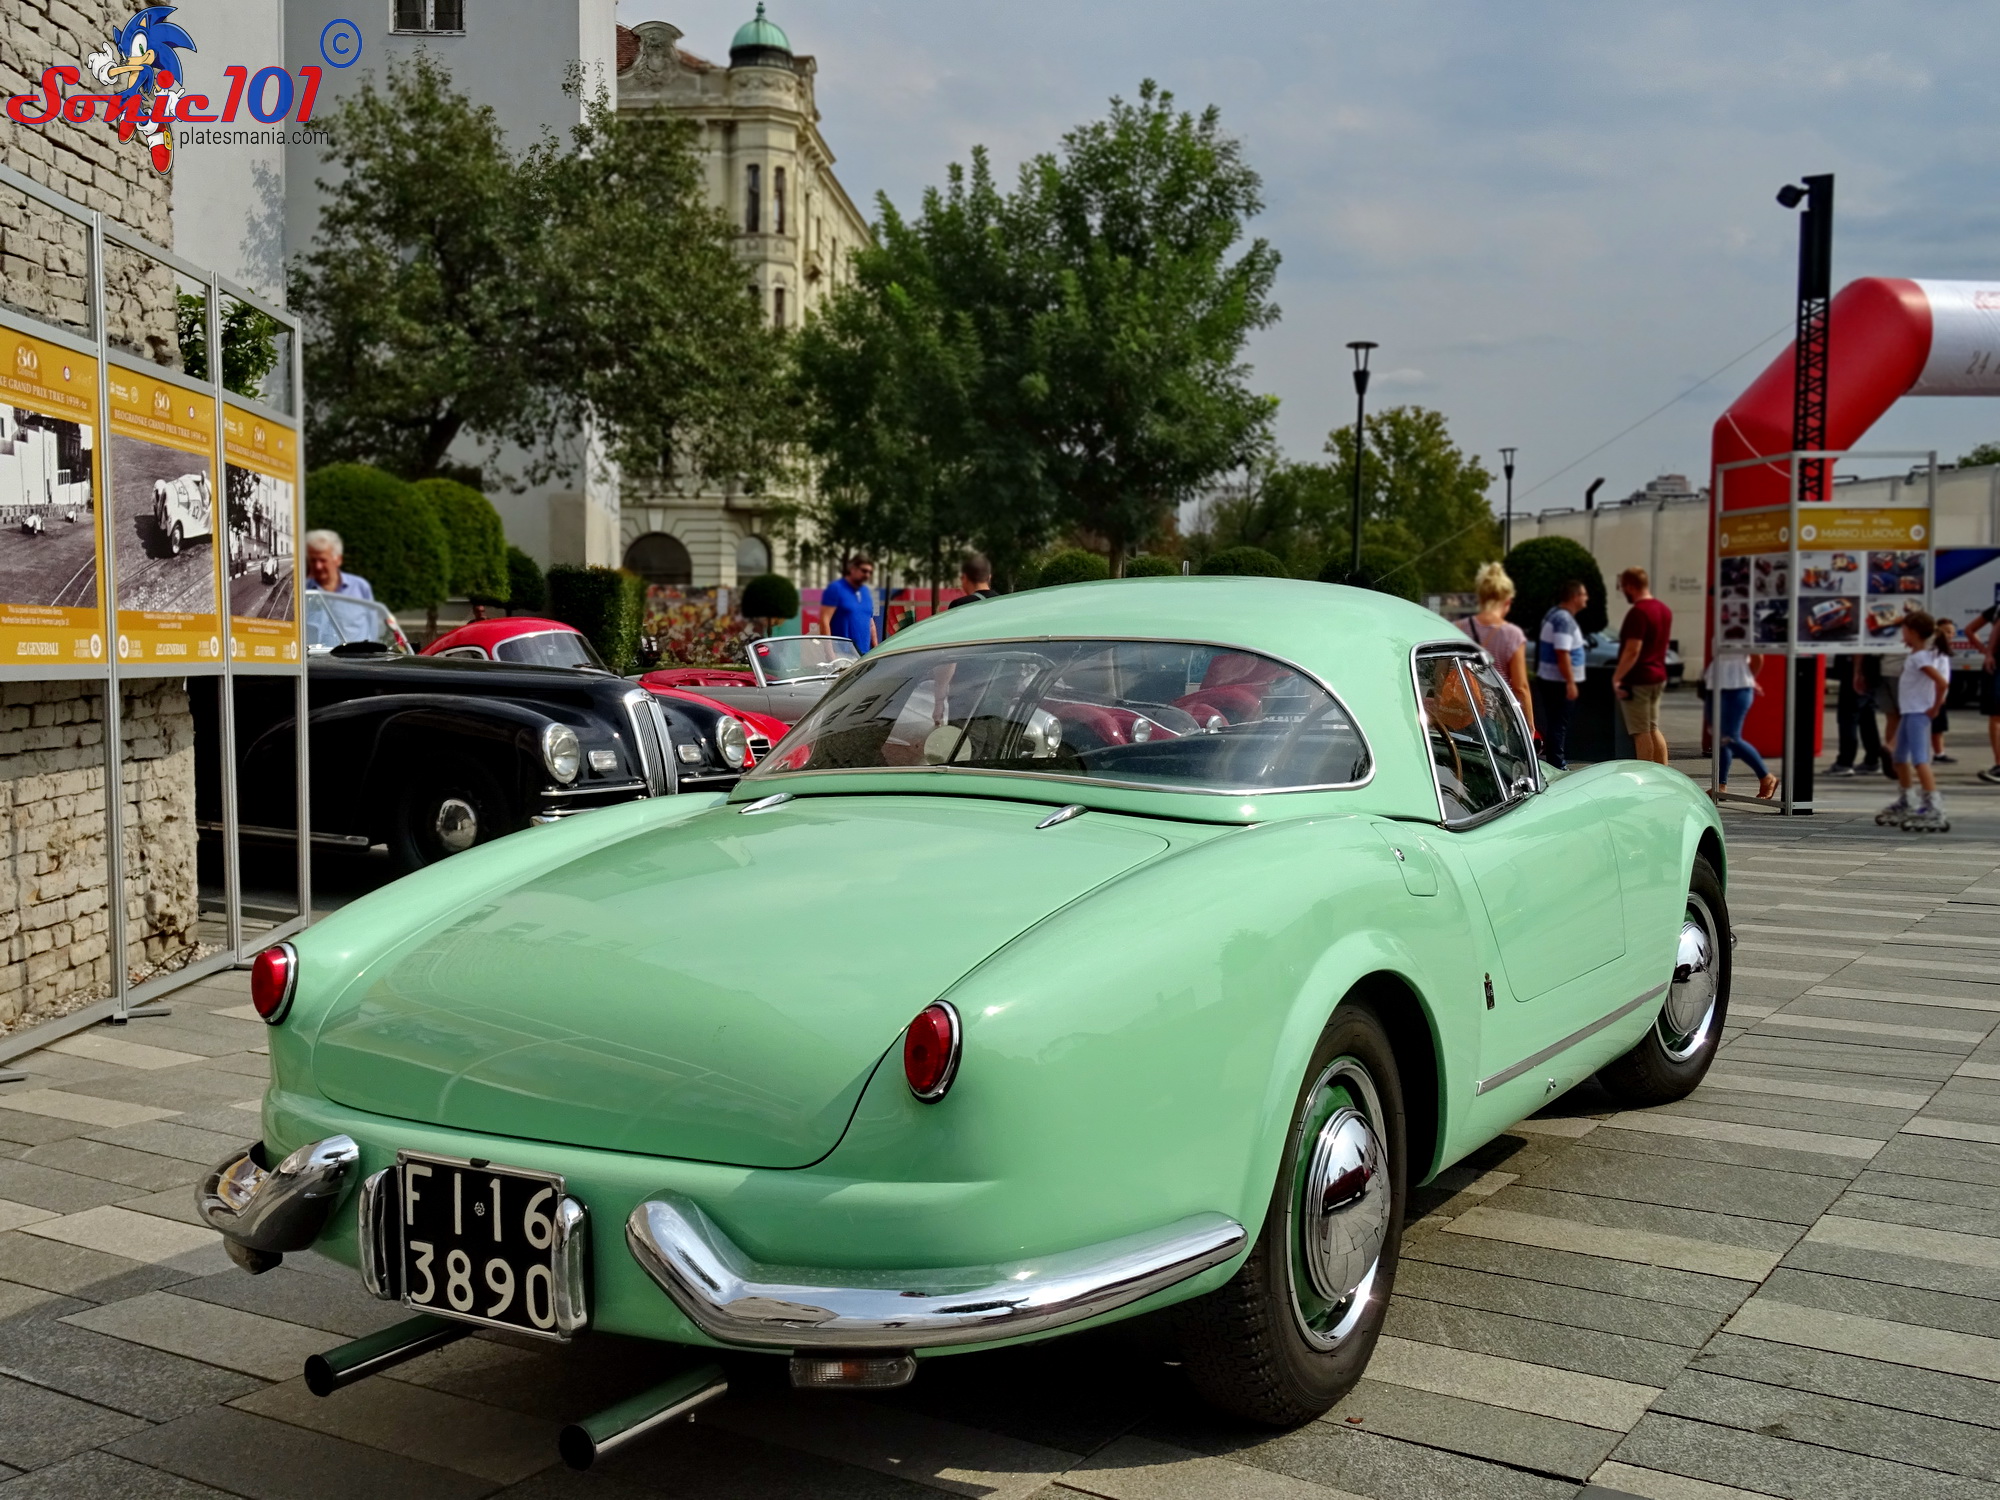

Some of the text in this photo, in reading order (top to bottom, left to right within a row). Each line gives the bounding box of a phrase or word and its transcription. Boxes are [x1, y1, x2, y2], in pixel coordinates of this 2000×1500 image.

[17, 346, 38, 371] 80
[8, 378, 32, 395] GRAND
[154, 390, 171, 411] 80
[27, 642, 59, 655] GENERALI
[410, 1240, 555, 1329] 3890
